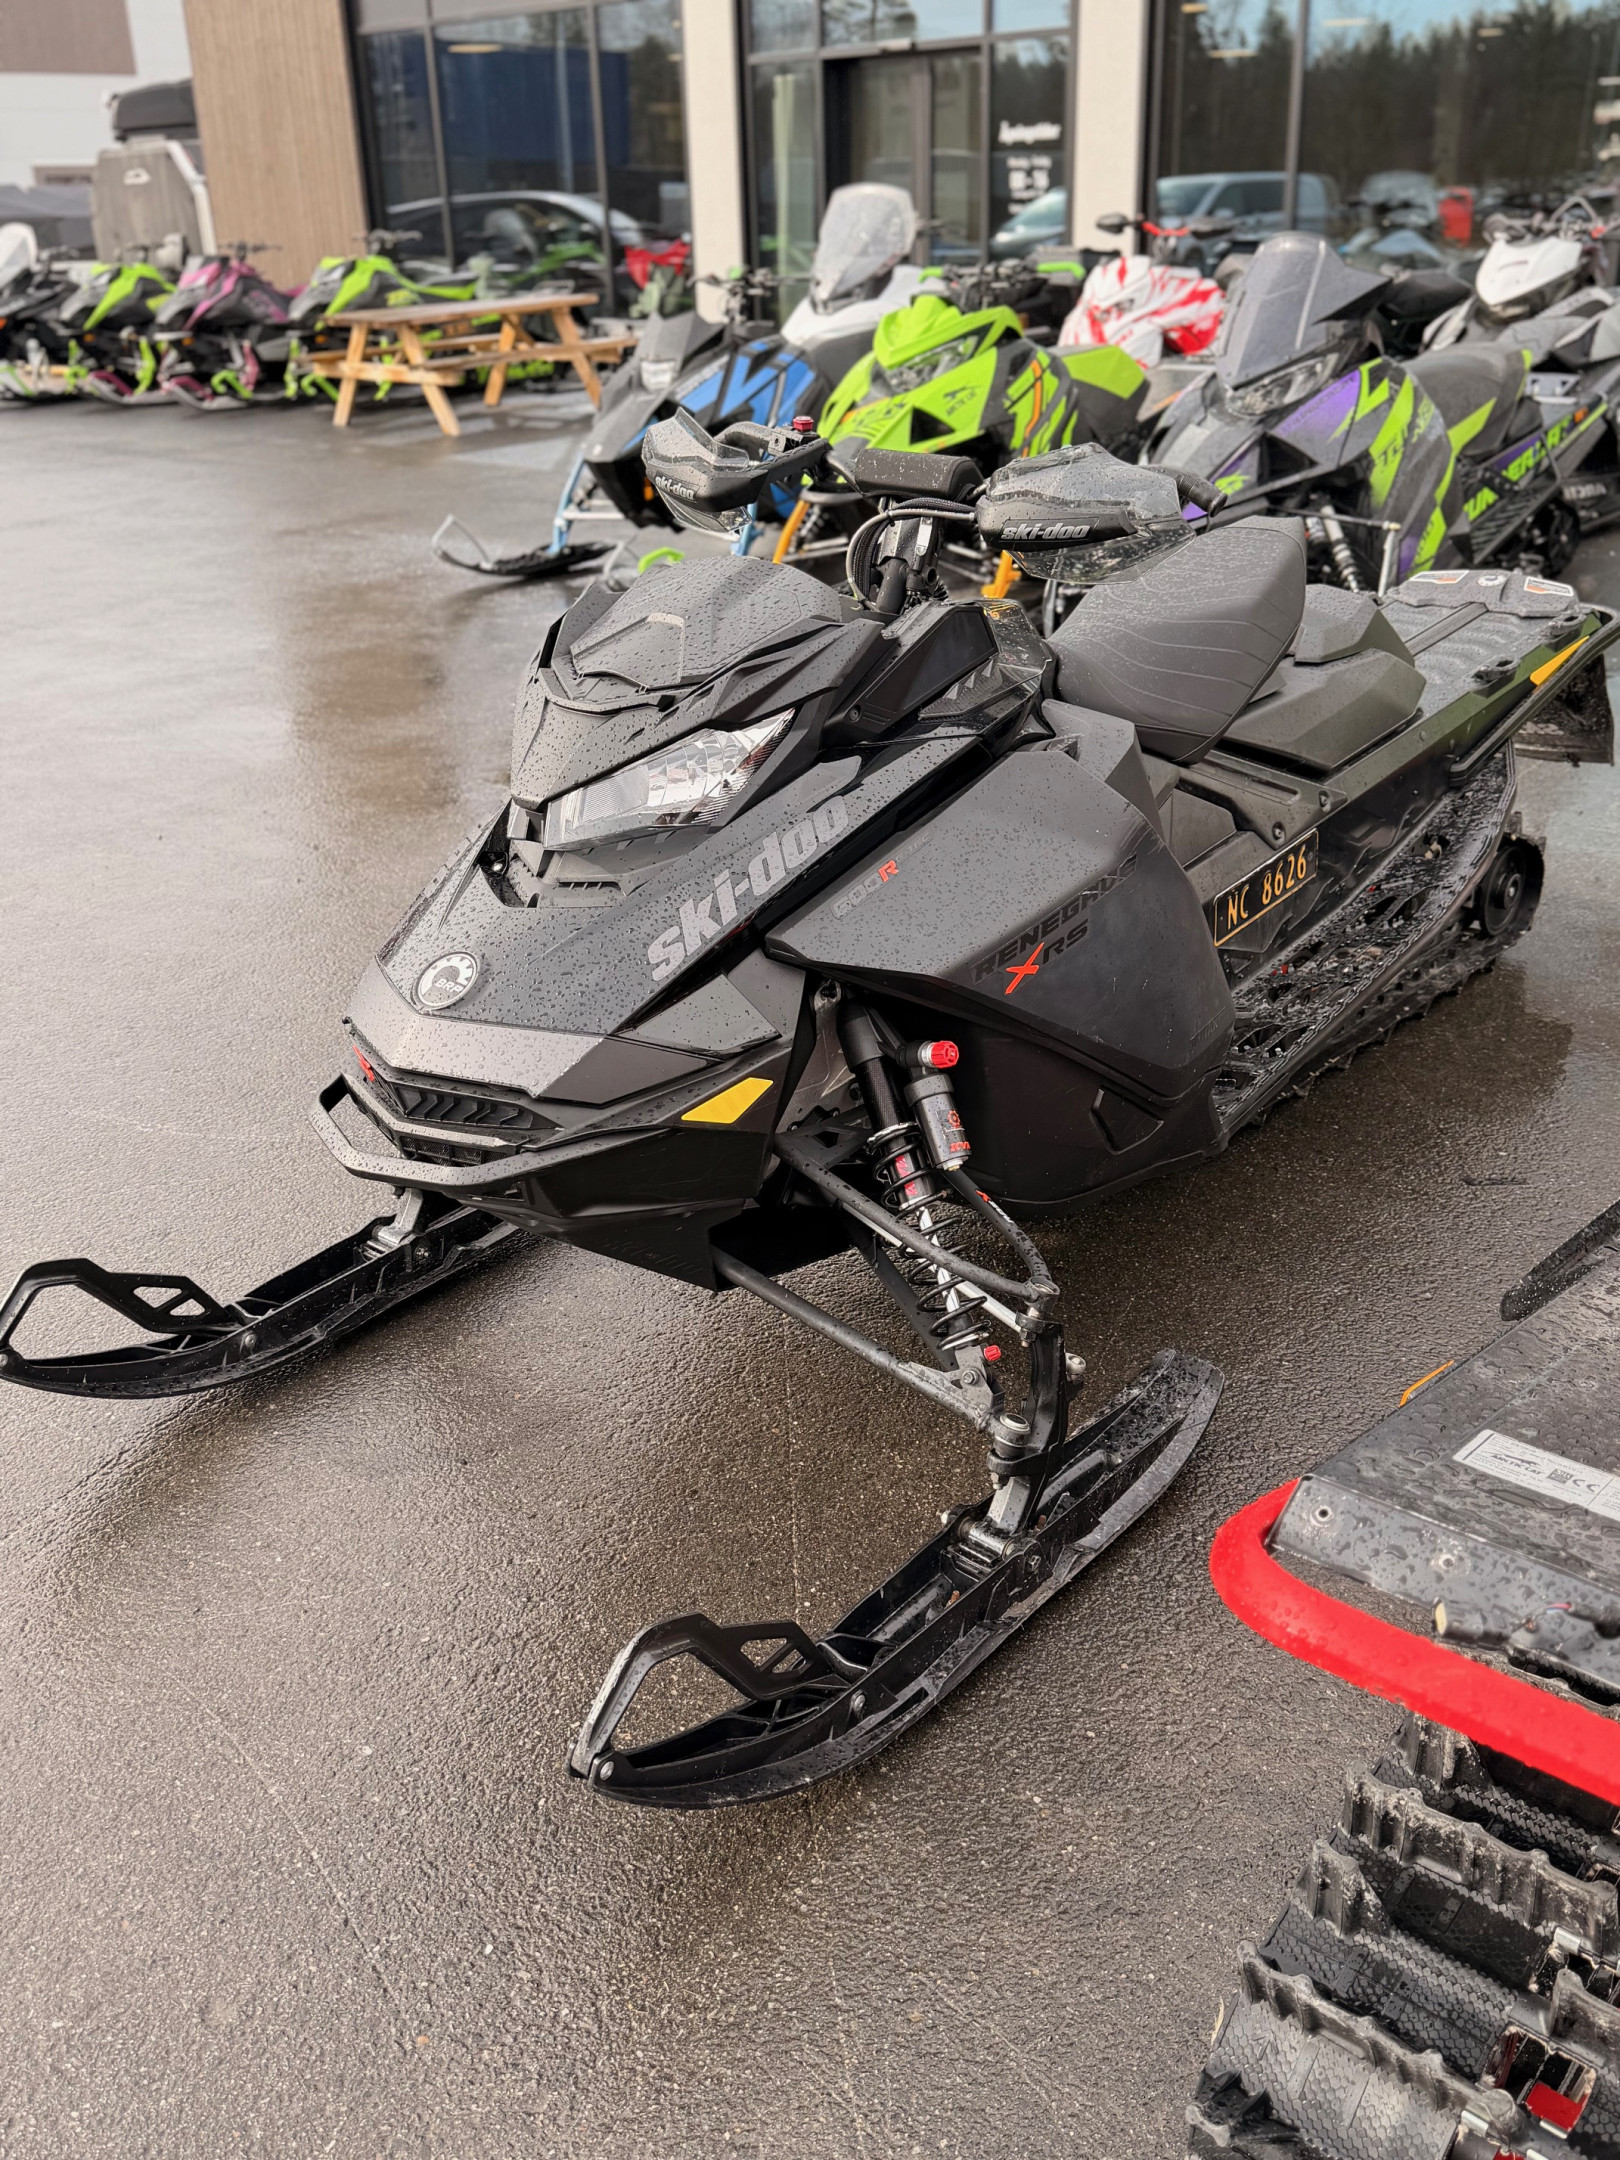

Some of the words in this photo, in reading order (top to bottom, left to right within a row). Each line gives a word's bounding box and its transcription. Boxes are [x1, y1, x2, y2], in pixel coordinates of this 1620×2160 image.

[655, 476, 694, 500] ski-doo
[1001, 523, 1090, 540] ski-doo
[647, 795, 849, 981] ski-doo
[1227, 884, 1250, 930] NC
[1262, 844, 1307, 905] 8626
[434, 978, 464, 993] BRP
